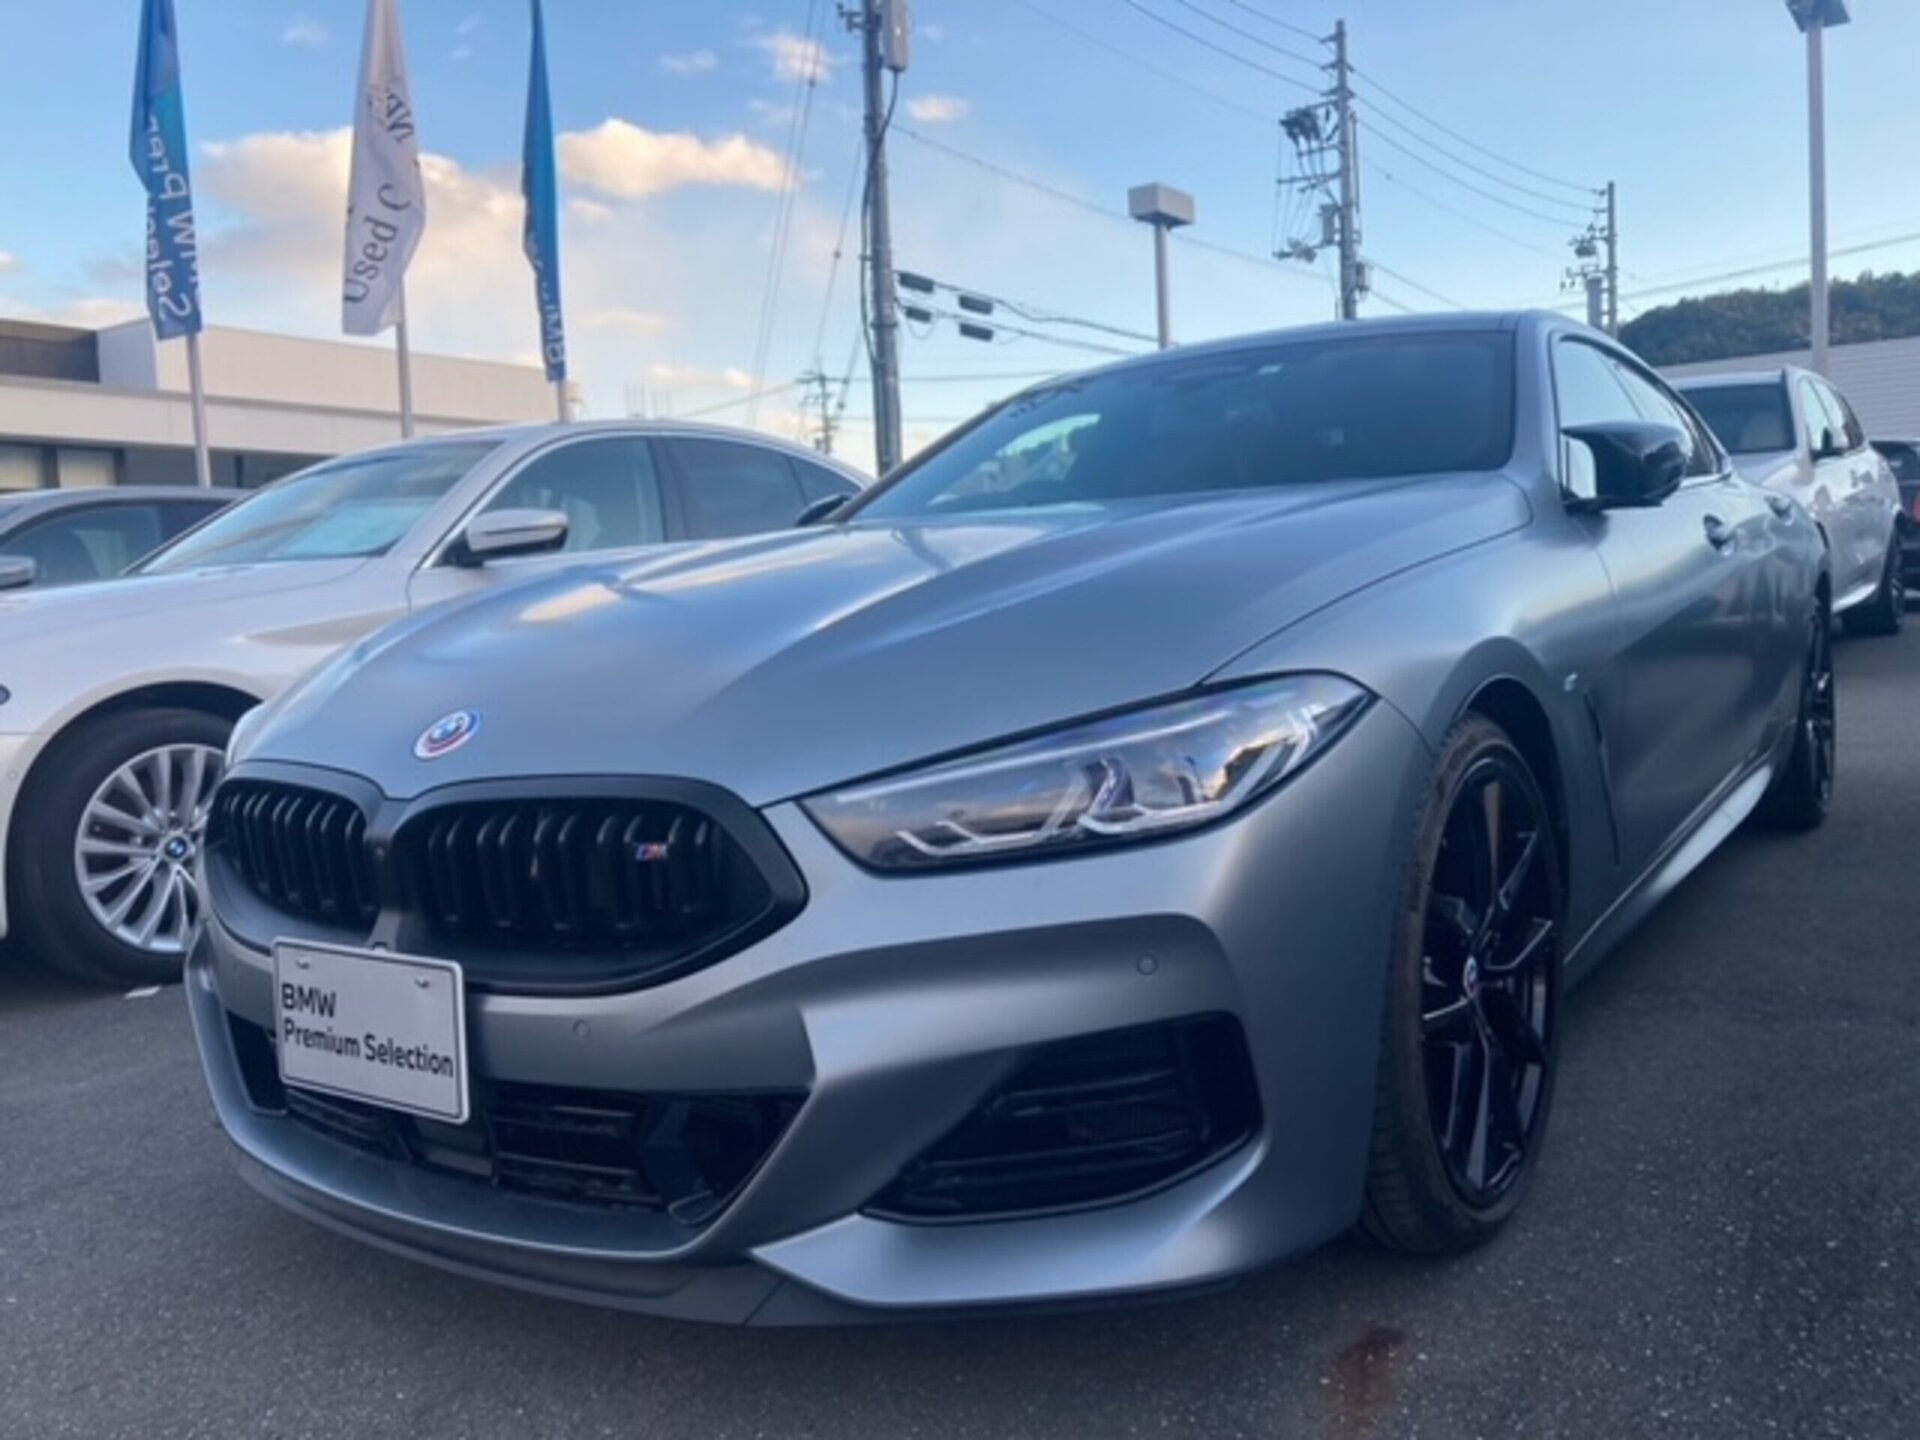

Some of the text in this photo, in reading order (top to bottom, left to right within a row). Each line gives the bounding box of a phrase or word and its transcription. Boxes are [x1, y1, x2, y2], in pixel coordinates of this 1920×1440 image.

[344, 216, 399, 303] Used
[282, 982, 337, 1018] BMW
[284, 1016, 455, 1078] Premium Selection
